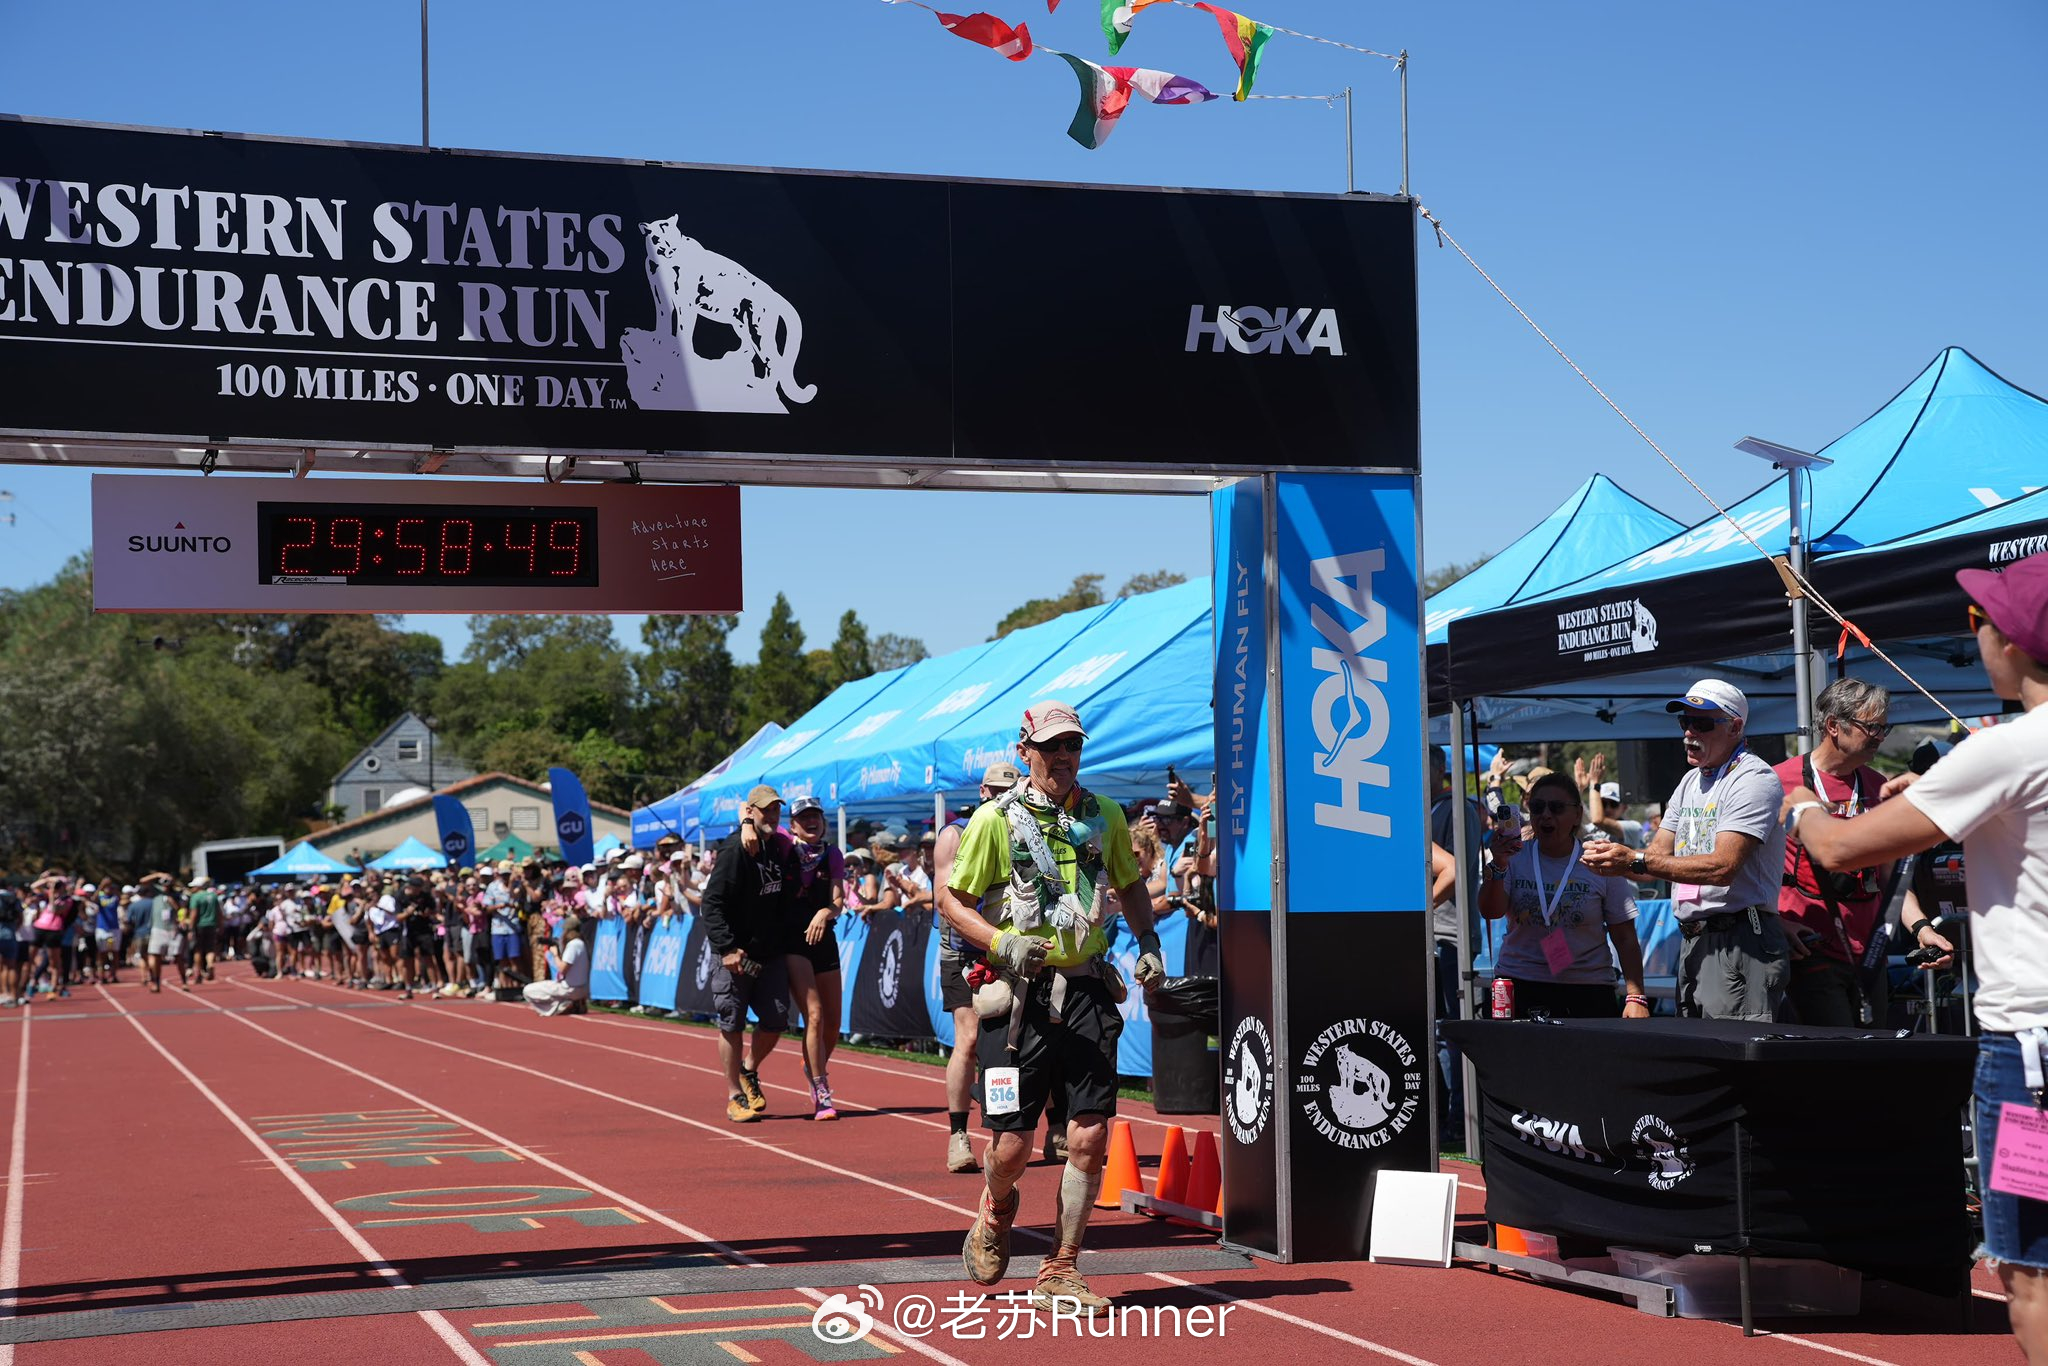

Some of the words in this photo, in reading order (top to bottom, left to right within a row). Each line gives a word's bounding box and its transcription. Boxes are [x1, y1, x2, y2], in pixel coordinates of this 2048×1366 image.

[0, 177, 347, 261] WESTERN
[372, 200, 626, 274] STATES
[457, 281, 610, 350] RUN
[1185, 304, 1345, 356] HOKA
[216, 363, 286, 398] 100
[293, 366, 420, 403] MILES
[446, 372, 525, 407] ONE
[535, 375, 610, 409] DAY
[128, 535, 232, 553] SUUNTO
[1988, 535, 2048, 563] WESTER
[1236, 560, 1250, 618] FLY
[1557, 607, 1599, 631] WESTERN
[1600, 600, 1633, 623] STATES
[1558, 624, 1610, 651] ENDURANCE
[1611, 621, 1631, 640] RUN
[1231, 630, 1250, 769] HUMAN
[1309, 547, 1392, 839] HOKA
[1231, 779, 1246, 837] FLY
[559, 820, 583, 834] GU
[1303, 1018, 1367, 1067] WESTERN
[1369, 1020, 1417, 1067] STATES
[992, 1077, 1012, 1086] MIKE
[1296, 1083, 1321, 1092] MILES
[1299, 1075, 1315, 1084] 100
[1404, 1073, 1422, 1081] ONE
[1404, 1081, 1421, 1090] DAY
[989, 1086, 1016, 1103] 316
[1303, 1100, 1392, 1149] ENDURANCE
[1389, 1097, 1419, 1135] RUN
